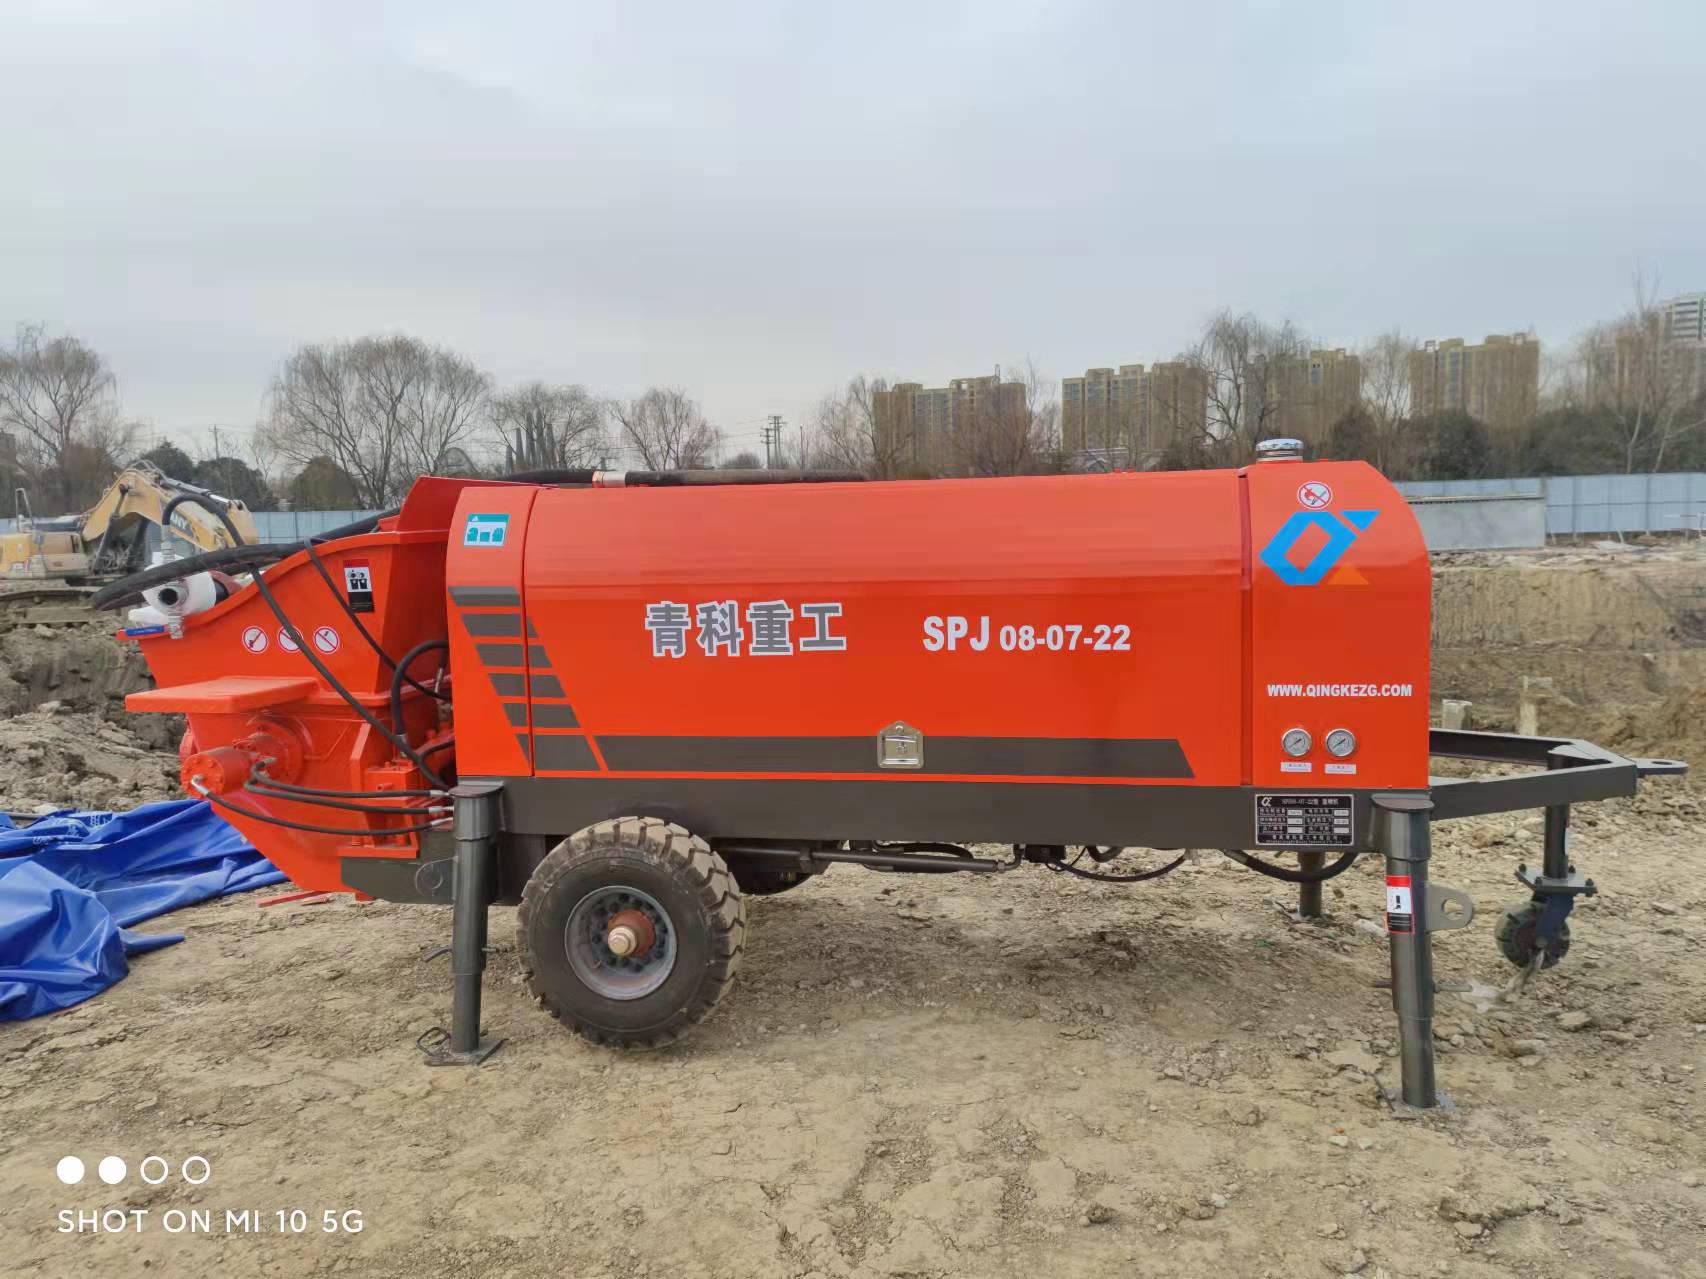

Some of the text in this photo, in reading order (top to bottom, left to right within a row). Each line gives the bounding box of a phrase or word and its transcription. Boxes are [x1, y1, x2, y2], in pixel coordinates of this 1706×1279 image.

[644, 600, 847, 659] 青科重工
[922, 615, 1131, 652] SPJ 08-07-22
[1267, 683, 1413, 698] WWW.QINGKEZG.COM
